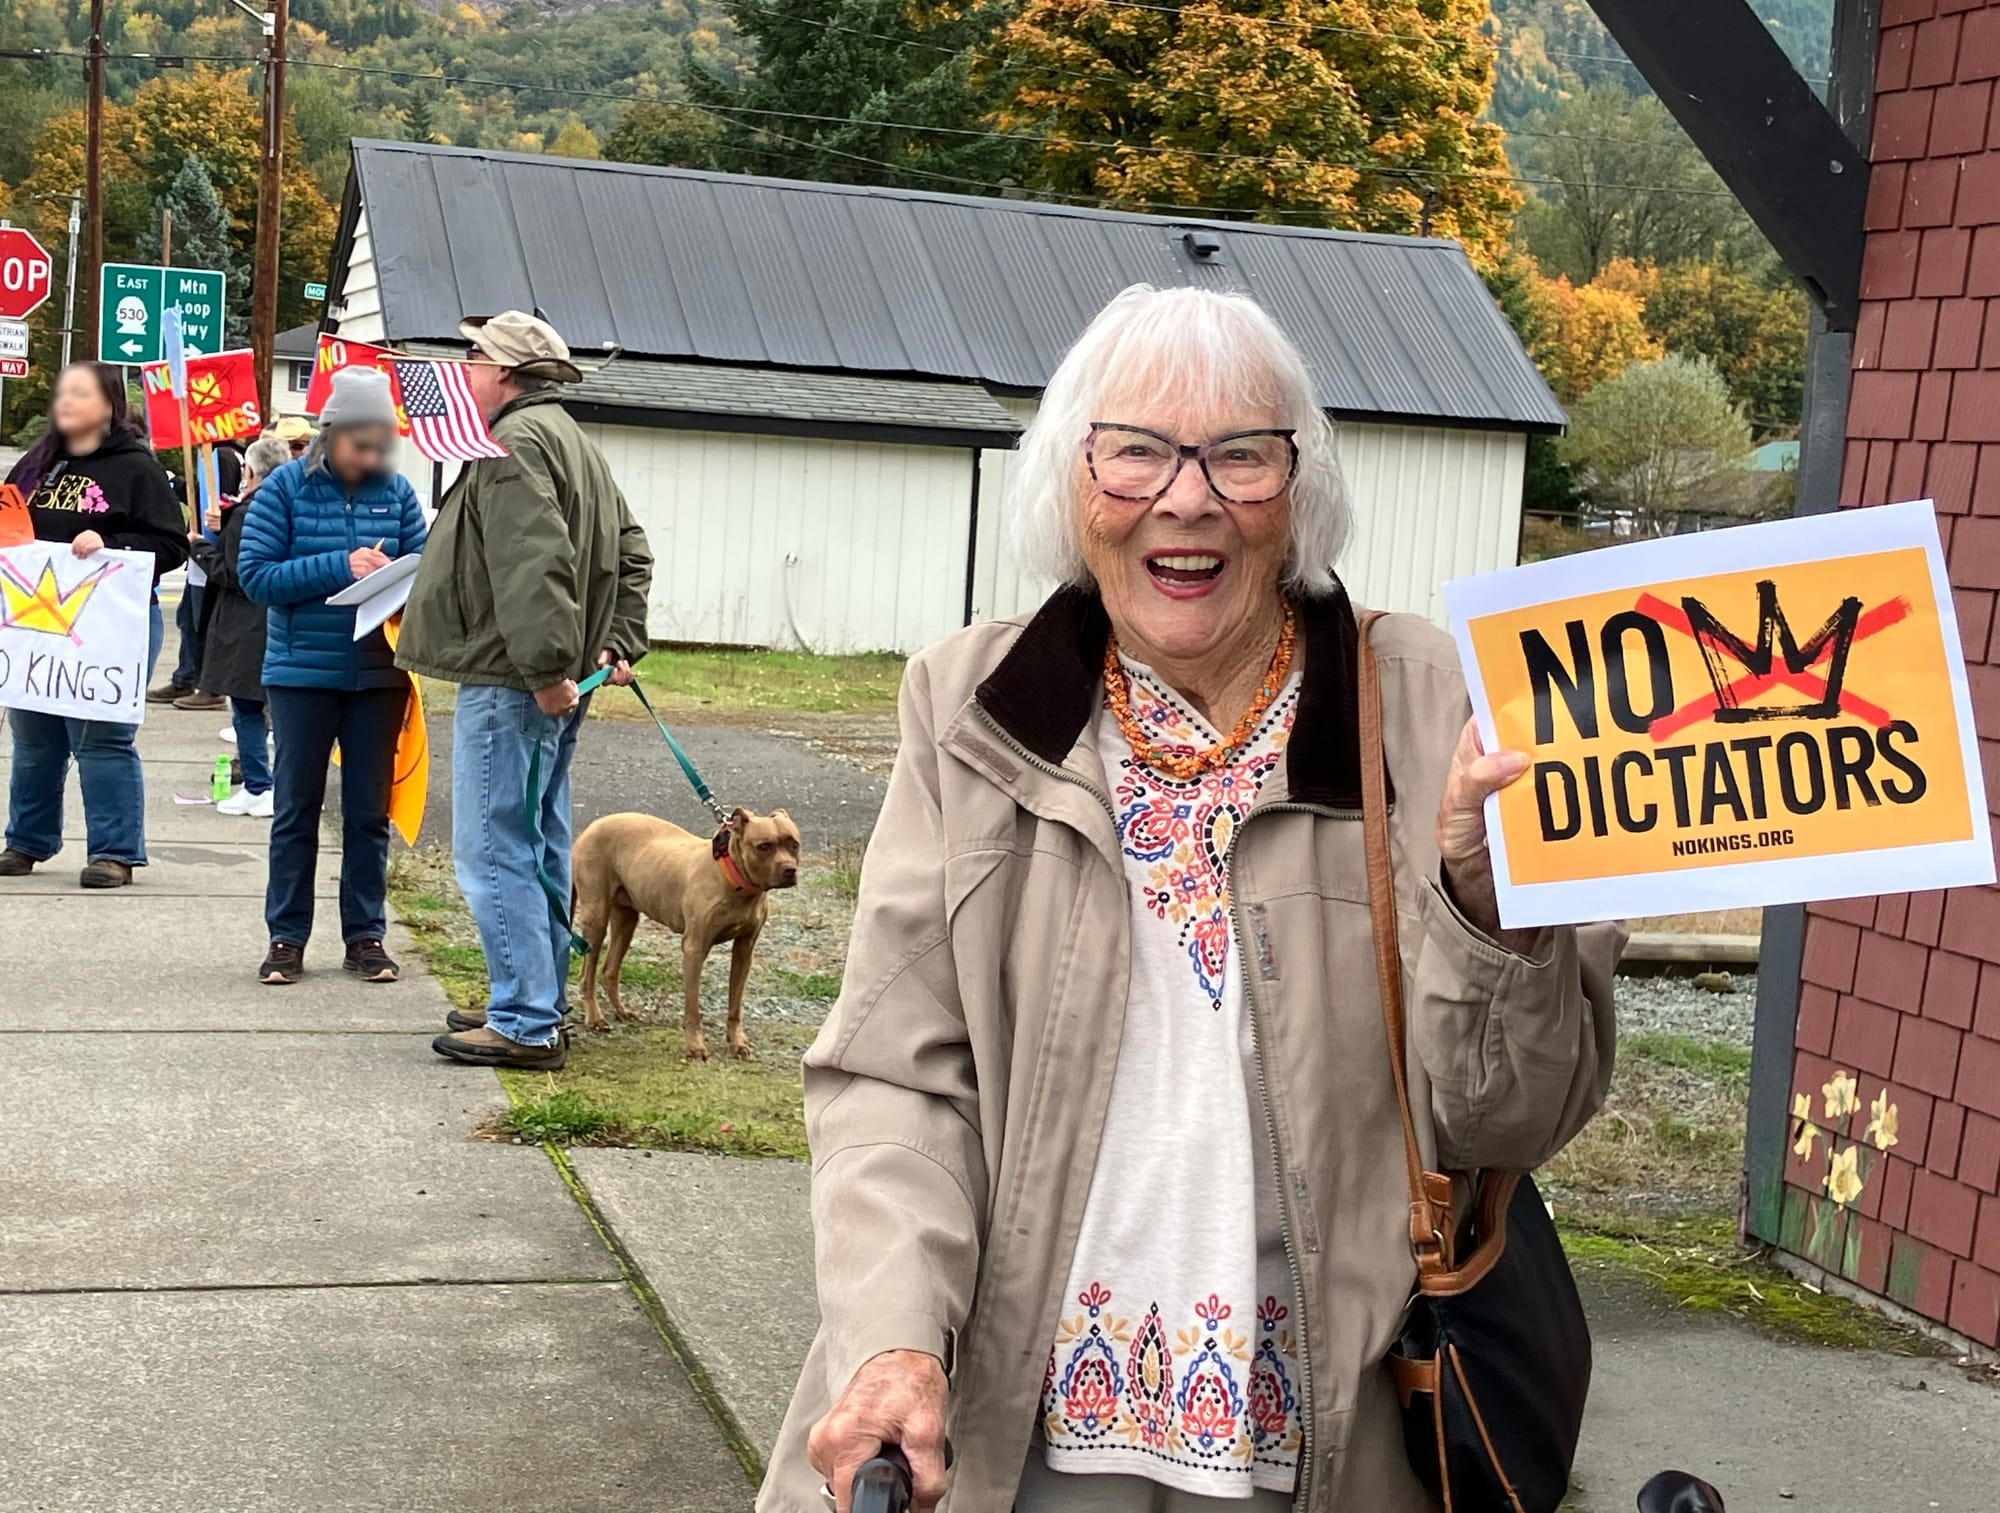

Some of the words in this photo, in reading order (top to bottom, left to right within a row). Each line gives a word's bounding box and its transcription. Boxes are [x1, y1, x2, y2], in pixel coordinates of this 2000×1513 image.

[0, 257, 48, 293] OP
[116, 274, 149, 290] EAST
[179, 278, 208, 295] Mtn
[119, 308, 145, 321] 530
[1, 361, 24, 374] WAY
[319, 340, 347, 374] NO
[25, 650, 141, 708] KINGS!
[1519, 610, 1675, 745] NO
[1534, 720, 1928, 842] DICTATORS
[1672, 829, 1794, 857] NOKINGS.ORG
